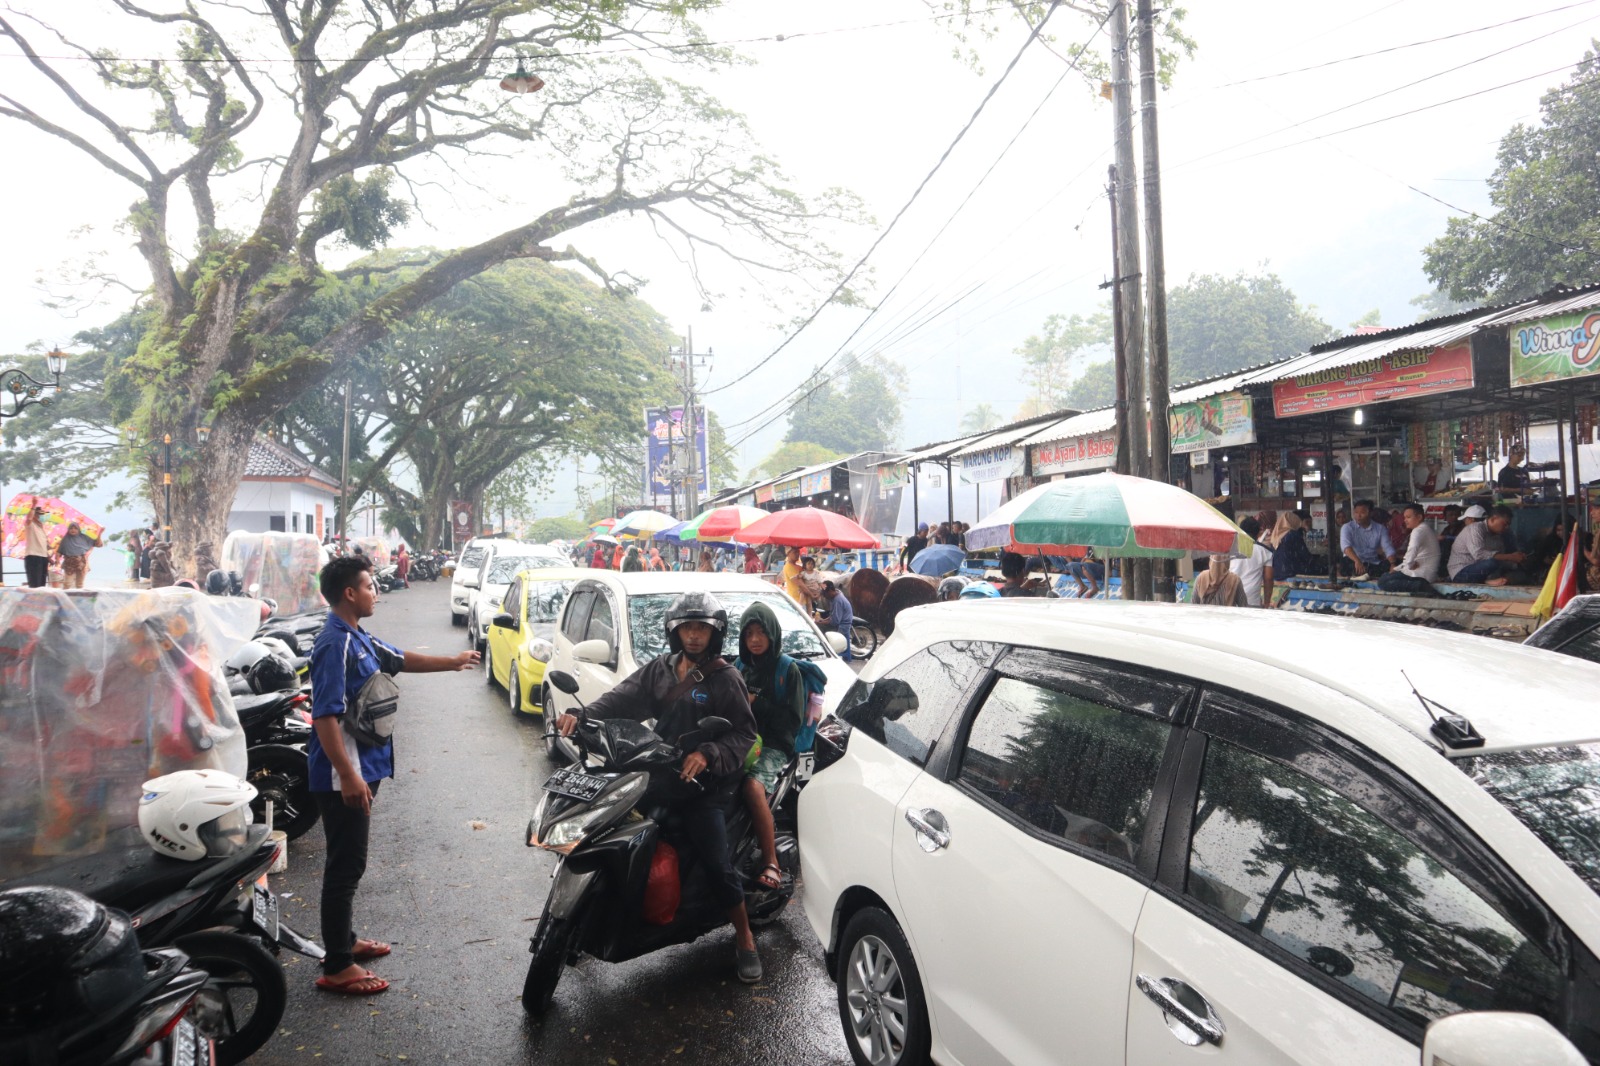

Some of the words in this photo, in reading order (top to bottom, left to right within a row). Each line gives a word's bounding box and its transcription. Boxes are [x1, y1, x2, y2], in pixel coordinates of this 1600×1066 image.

[1350, 359, 1383, 377] KOPI
[963, 450, 992, 469] WARUNG
[993, 445, 1012, 463] KOPI
[1054, 443, 1076, 467] Ayam
[1078, 439, 1085, 460] &
[1087, 437, 1115, 459] Bakso
[551, 770, 567, 781] AE
[565, 773, 589, 785] 2648
[591, 827, 616, 843] HONDA
